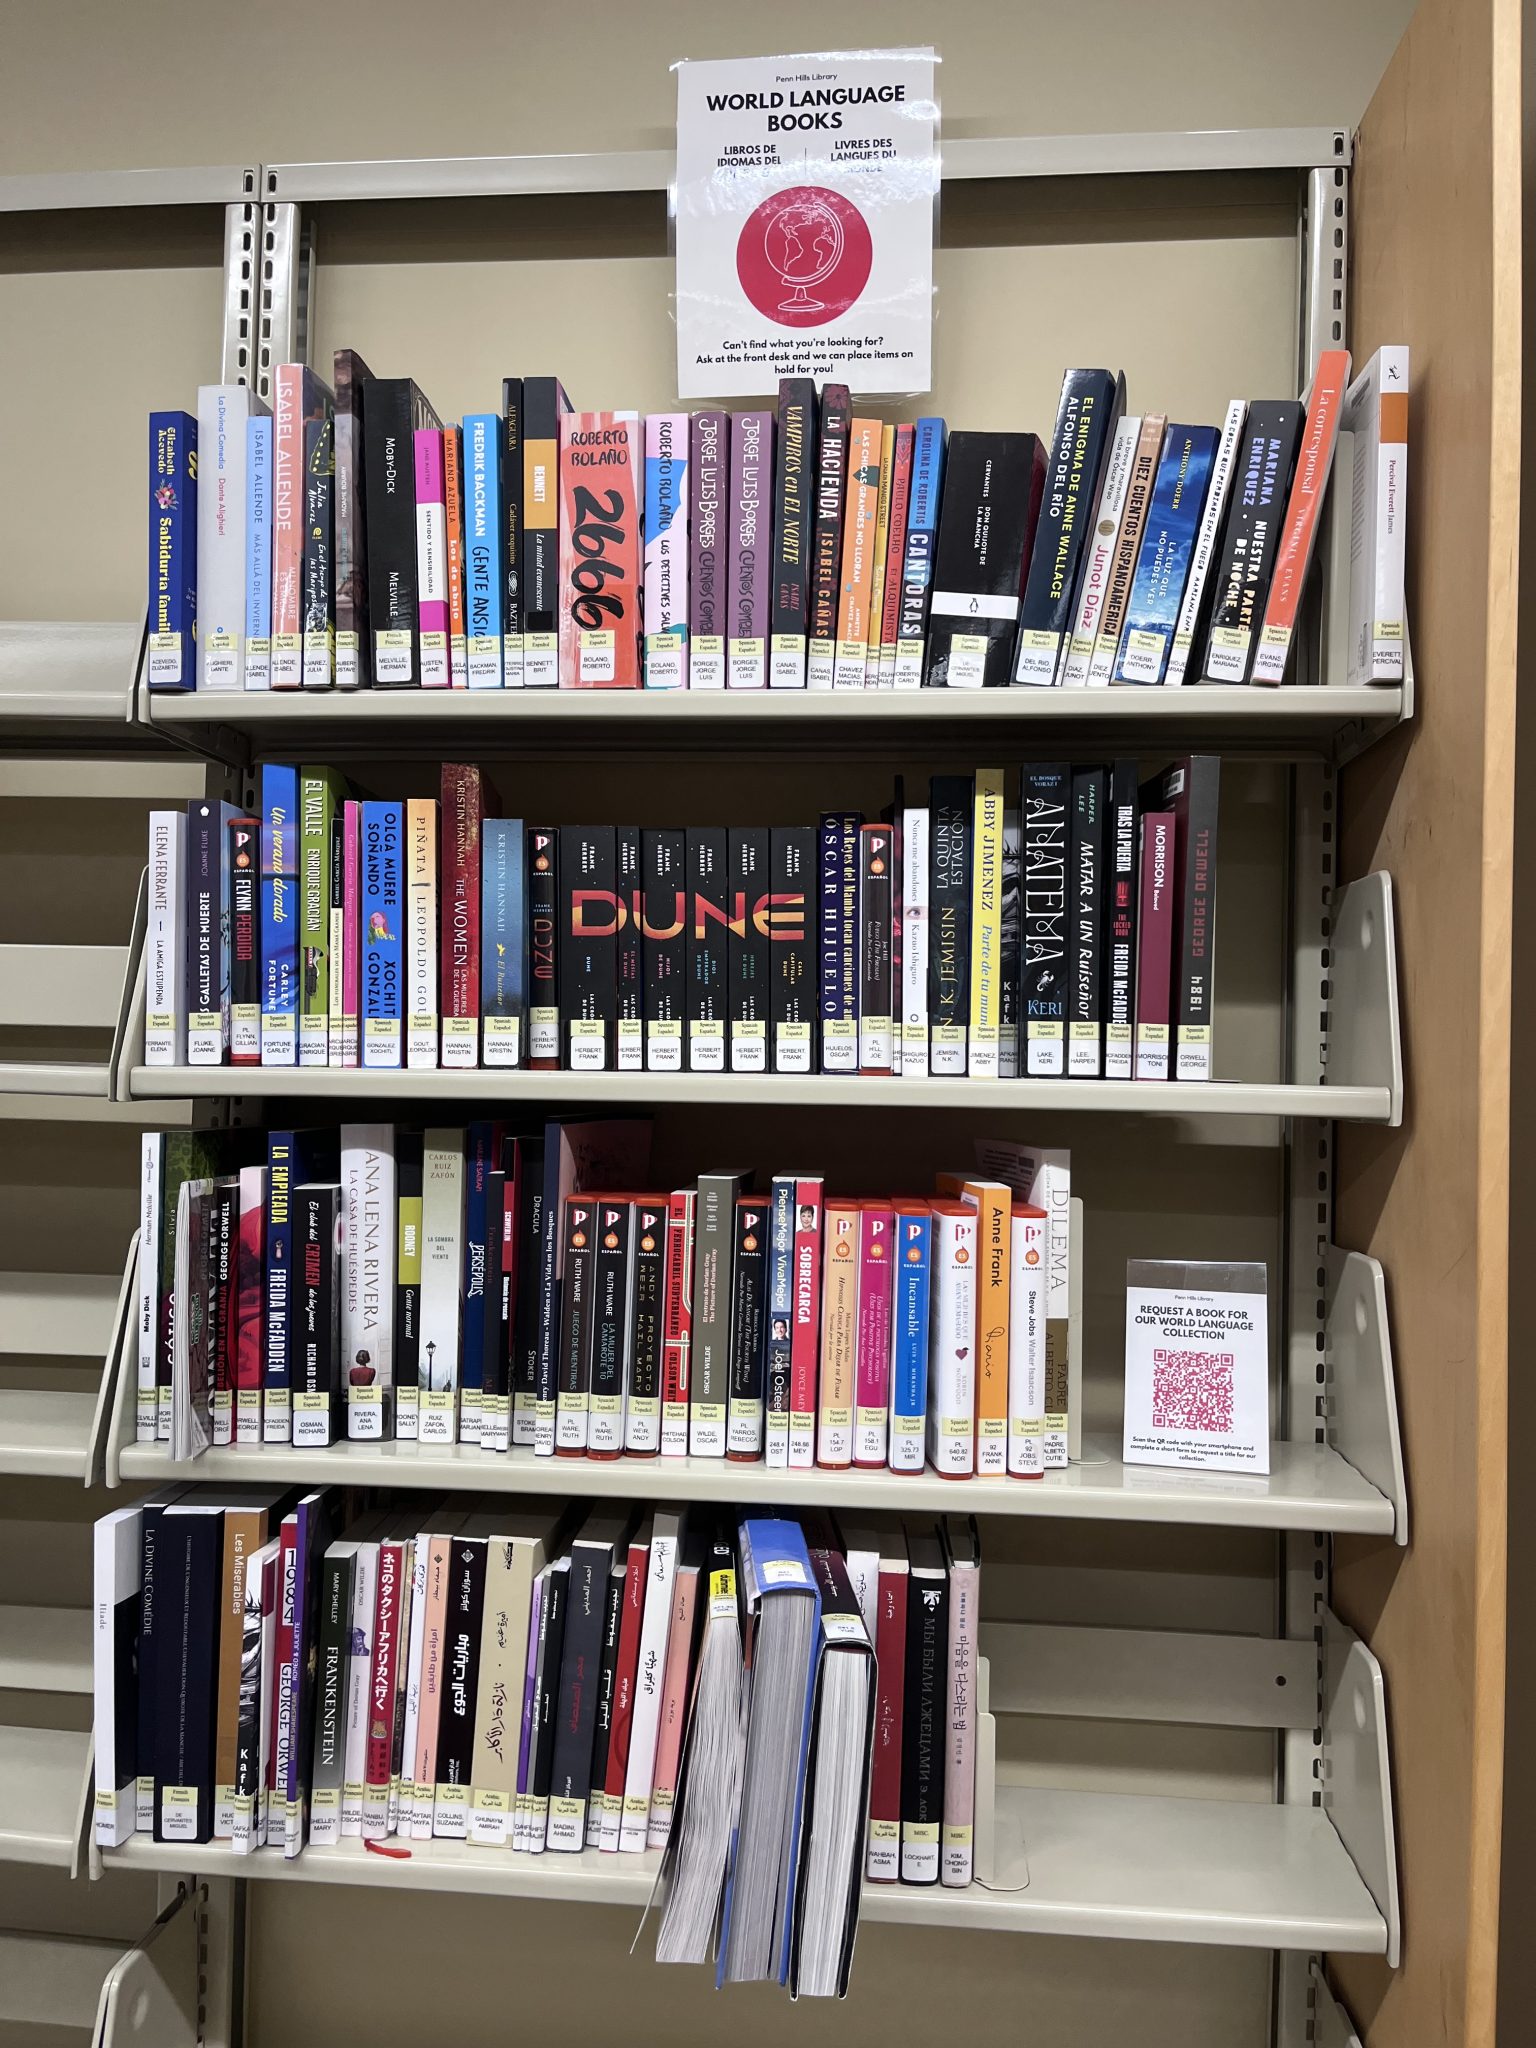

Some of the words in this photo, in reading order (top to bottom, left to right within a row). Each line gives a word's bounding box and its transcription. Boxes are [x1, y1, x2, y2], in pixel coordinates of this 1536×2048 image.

[796, 74, 809, 82] Hills
[812, 73, 838, 81] Library
[707, 92, 783, 111] WORLD
[790, 85, 905, 108] LANGUAGE
[767, 112, 842, 132] BOOKS
[717, 156, 762, 167] IDIOMAS
[764, 155, 781, 165] DEL
[724, 145, 760, 155] LIBROS
[763, 145, 776, 153] DE
[830, 151, 879, 161] LANGUES
[881, 150, 896, 159] DU
[835, 140, 870, 150] LIVRES
[872, 139, 892, 148] DES
[696, 355, 713, 364] Ask
[715, 355, 725, 363] at
[727, 354, 742, 362] the
[744, 353, 766, 362] front
[769, 352, 790, 361] desk
[792, 352, 810, 360] and
[829, 351, 845, 359] can
[848, 350, 872, 361] place
[875, 349, 899, 359] items
[901, 350, 913, 358] on
[723, 341, 747, 349] Can't
[749, 340, 767, 349] find
[770, 339, 794, 348] what
[796, 338, 825, 348] you're
[828, 337, 863, 348] looking
[865, 337, 883, 346] for?
[775, 365, 795, 374] hold
[797, 365, 809, 374] for
[812, 364, 833, 375] you!
[277, 382, 293, 446] ISABEL
[1082, 397, 1094, 413] EL
[1321, 388, 1334, 409] La
[570, 430, 628, 447] ROBERTO
[827, 415, 840, 429] LA
[1060, 397, 1079, 461] ALFONSO
[474, 422, 485, 470] FREDRIK
[571, 449, 627, 466] BOLAÑO
[699, 419, 717, 463] JORGE
[1072, 416, 1091, 470] ENIGMA
[1300, 413, 1326, 494] corresponsal
[277, 451, 293, 530] ALLENDE
[534, 466, 545, 502] BENNETT
[700, 467, 716, 499] LUIS
[819, 438, 842, 520] HACIENDA
[1054, 465, 1067, 490] DEL
[1069, 473, 1081, 492] DE
[474, 474, 486, 537] BACKMAN
[698, 500, 718, 548] BORGES
[1049, 493, 1064, 518] RÍO
[1062, 495, 1077, 532] ANNE
[571, 485, 625, 631] 2666
[819, 532, 834, 583] ISABEL
[1050, 536, 1071, 599] WALLACE
[389, 572, 398, 617] MELVILLE
[902, 534, 928, 634] CANTORAS
[816, 590, 831, 637] CAÑAS
[305, 780, 323, 793] EL
[457, 779, 466, 816] KRISTIN
[304, 796, 323, 836] VALLE
[983, 788, 995, 829] ABBY
[1117, 805, 1132, 825] TRAS
[156, 826, 168, 860] ELENA
[384, 813, 396, 853] OLGA
[416, 818, 426, 873] PIÑATA
[457, 819, 465, 867] HANNAH
[1117, 827, 1132, 837] LA
[367, 823, 380, 895] SOÑANDO
[982, 833, 995, 911] JIMENEZ
[1116, 839, 1131, 872] PUERTA
[1155, 825, 1166, 888] MORRISON
[155, 861, 167, 911] FERRANTE
[384, 859, 396, 905] MUERE
[455, 879, 465, 896] THE
[453, 900, 467, 965] WOMEN
[572, 890, 805, 941] DUNE
[272, 1146, 289, 1159] LA
[364, 1151, 381, 1195] ANA
[271, 1166, 289, 1224] EMPLEADA
[220, 1202, 230, 1237] ORWELL
[363, 1200, 380, 1255] LENA
[992, 1207, 1004, 1244] Anne
[1051, 1189, 1069, 1291] DILEMA
[219, 1239, 228, 1280] GEORGE
[574, 1258, 582, 1279] RUTH
[991, 1247, 1003, 1288] Frank
[269, 1269, 287, 1307] FREIDA
[363, 1259, 379, 1331] RIVERA
[573, 1280, 581, 1302] WARE
[798, 1246, 812, 1324] SOBRECARGA
[1028, 1290, 1036, 1314] Steve
[1135, 1316, 1156, 1325] OUR
[1159, 1317, 1196, 1327] WORLD
[1198, 1320, 1253, 1331] LANGUAGE
[1140, 1305, 1184, 1316] REQUEST
[1186, 1308, 1194, 1316] A
[1196, 1309, 1225, 1318] BOOK
[1228, 1310, 1248, 1319] FOR
[1163, 1328, 1225, 1339] COLLECTION
[703, 1372, 711, 1394] OSCAR
[1179, 1454, 1206, 1462] collection.
[1208, 1442, 1242, 1450] smartphone
[145, 1529, 155, 1546] LA
[235, 1533, 244, 1552] Les
[145, 1547, 155, 1582] DIVINE
[233, 1557, 244, 1615] Miserables
[284, 1549, 296, 1624] 1984
[375, 1553, 395, 1710] ネコのタクシーアフリカへ行く
[955, 1634, 968, 1669] 마음을
[322, 1646, 339, 1765] FRANKENSTEIN
[954, 1673, 968, 1716] 다스리는
[953, 1719, 966, 1731] 법
[553, 1830, 575, 1838] AHMAD
